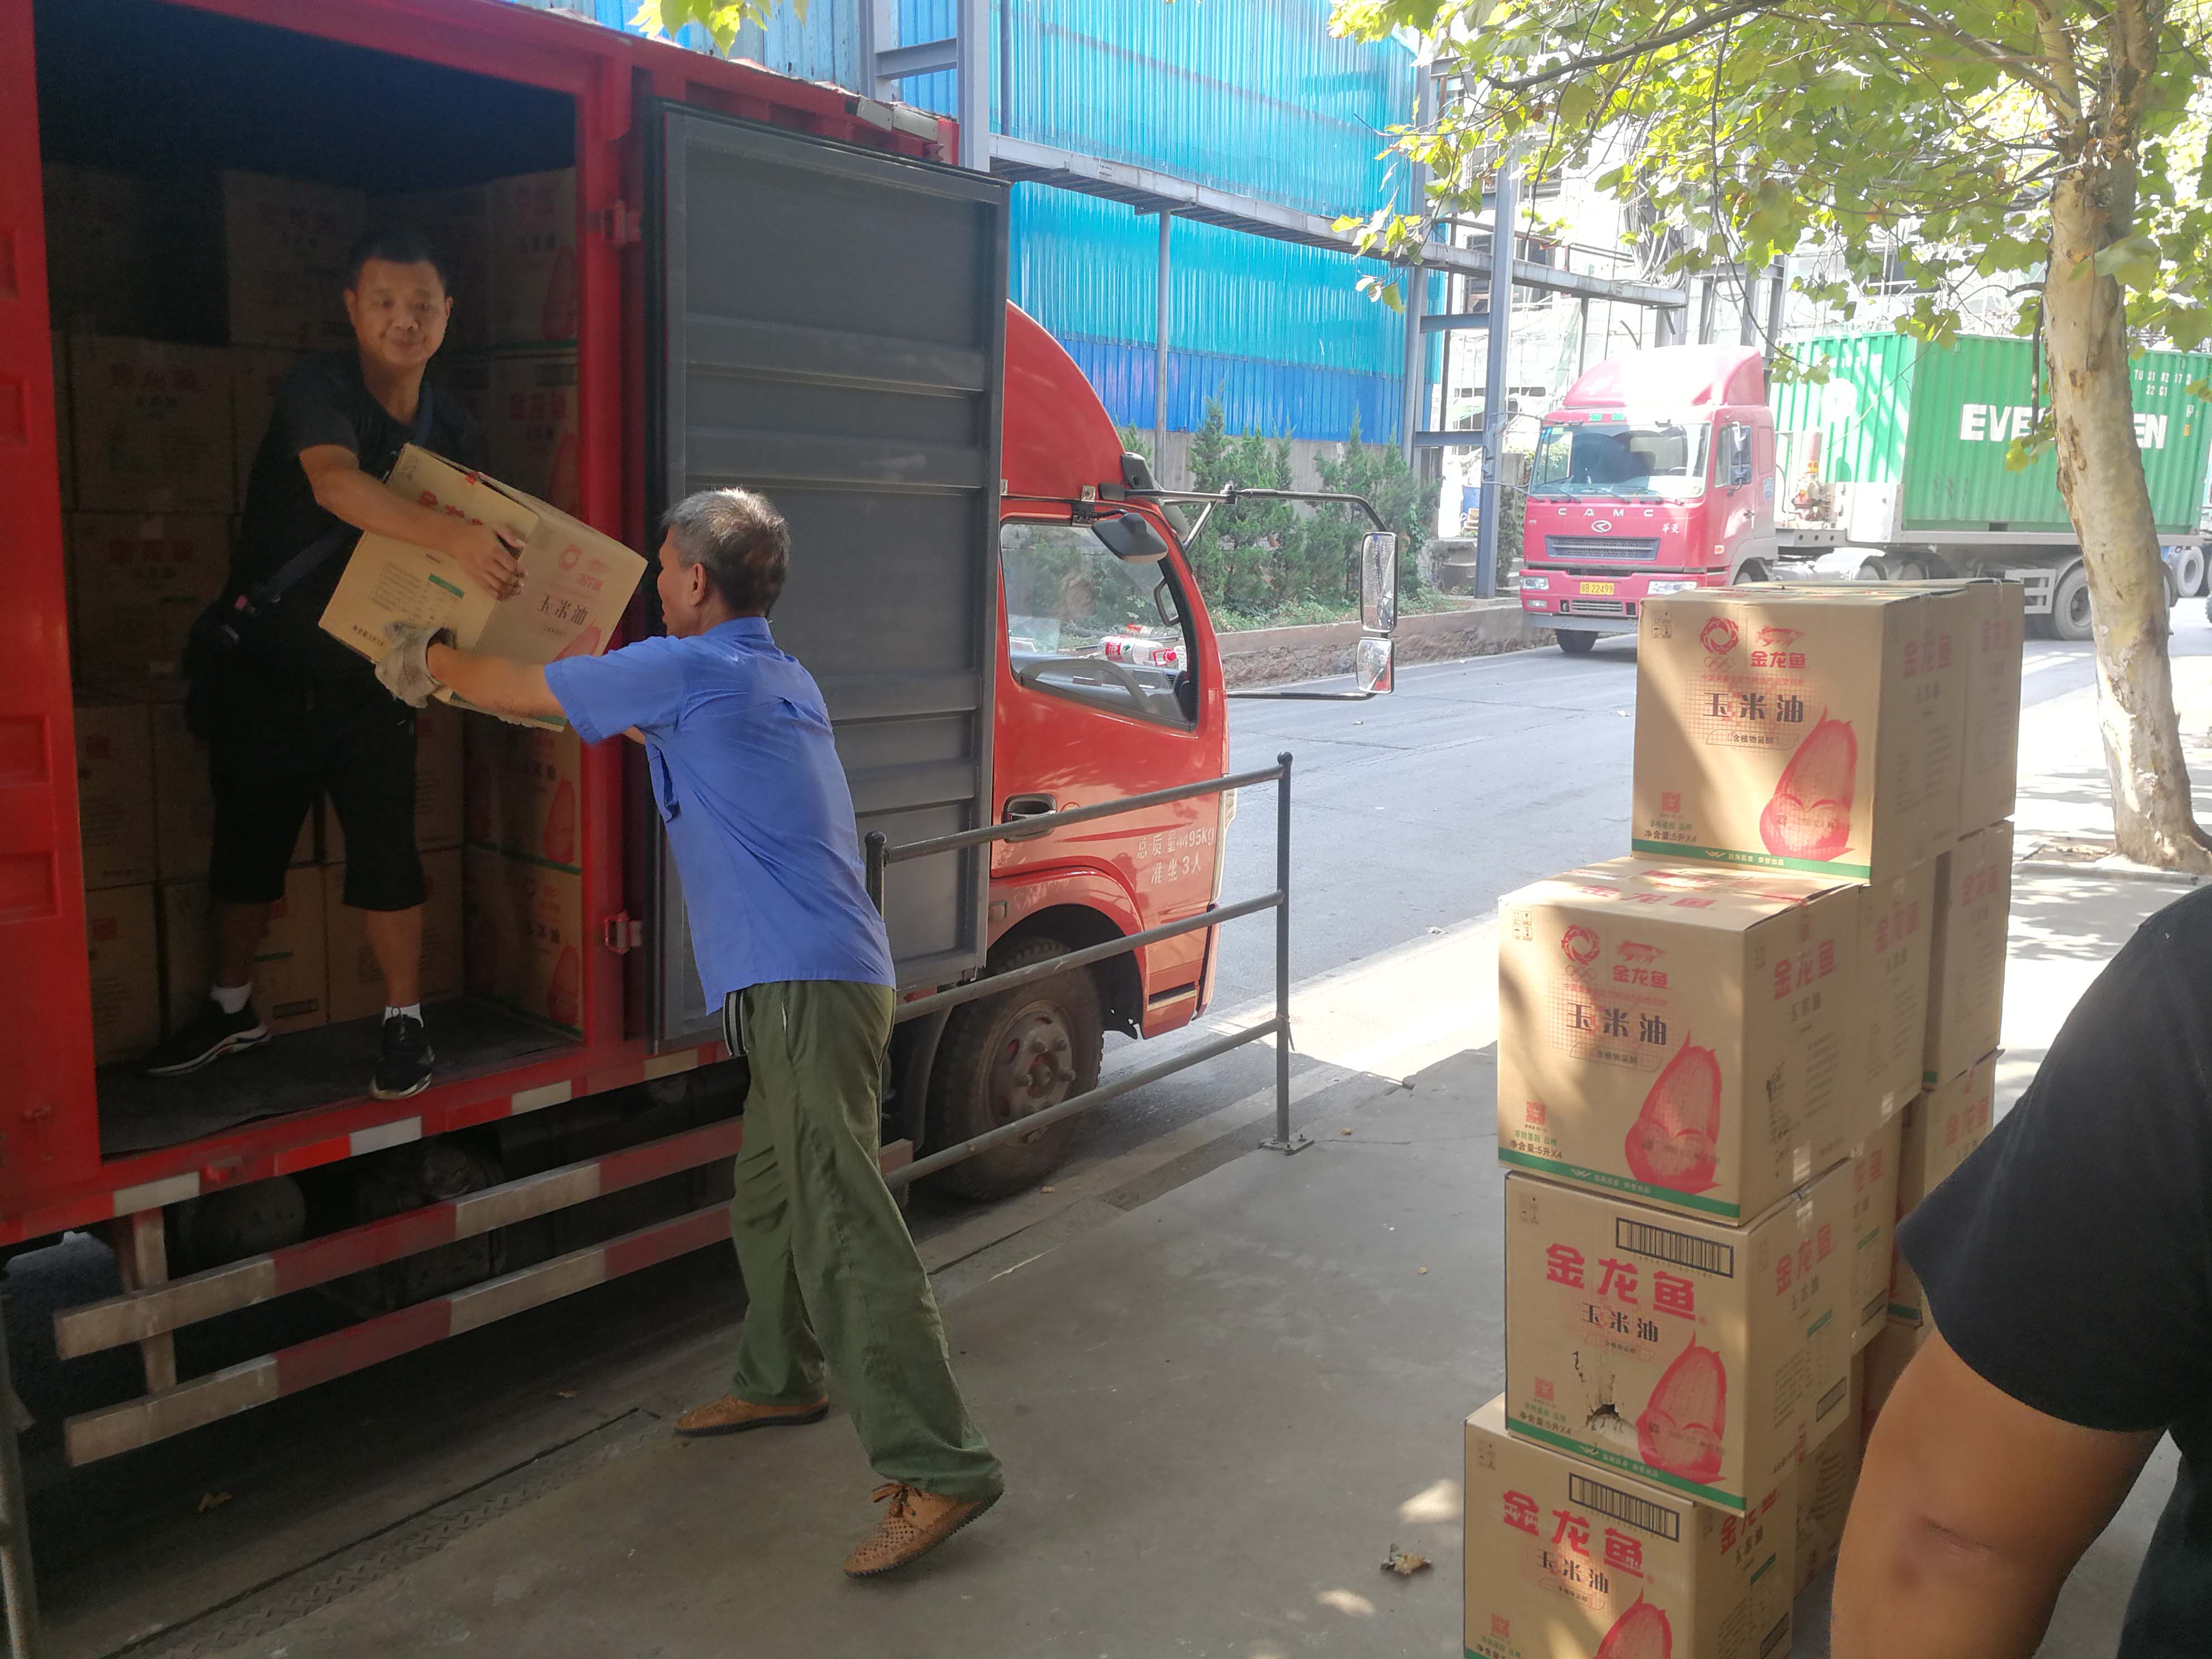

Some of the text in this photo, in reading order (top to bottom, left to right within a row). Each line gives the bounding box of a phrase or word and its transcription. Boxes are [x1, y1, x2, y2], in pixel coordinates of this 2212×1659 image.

[1558, 508, 1654, 517] CAMC
[1750, 651, 1806, 668] 金龙鱼
[1702, 692, 1804, 723] 玉米油
[1612, 964, 1668, 989] 金龙鱼
[1774, 938, 1836, 1001] 金龙鱼
[1566, 1002, 1667, 1045] 玉米油
[1776, 1221, 1833, 1297] 金龙鱼
[1546, 1243, 1696, 1321] 金龙鱼
[1582, 1302, 1658, 1342] 玉米油
[1503, 1489, 1644, 1579] 金龙鱼
[1537, 1547, 1609, 1594] 玉米油
